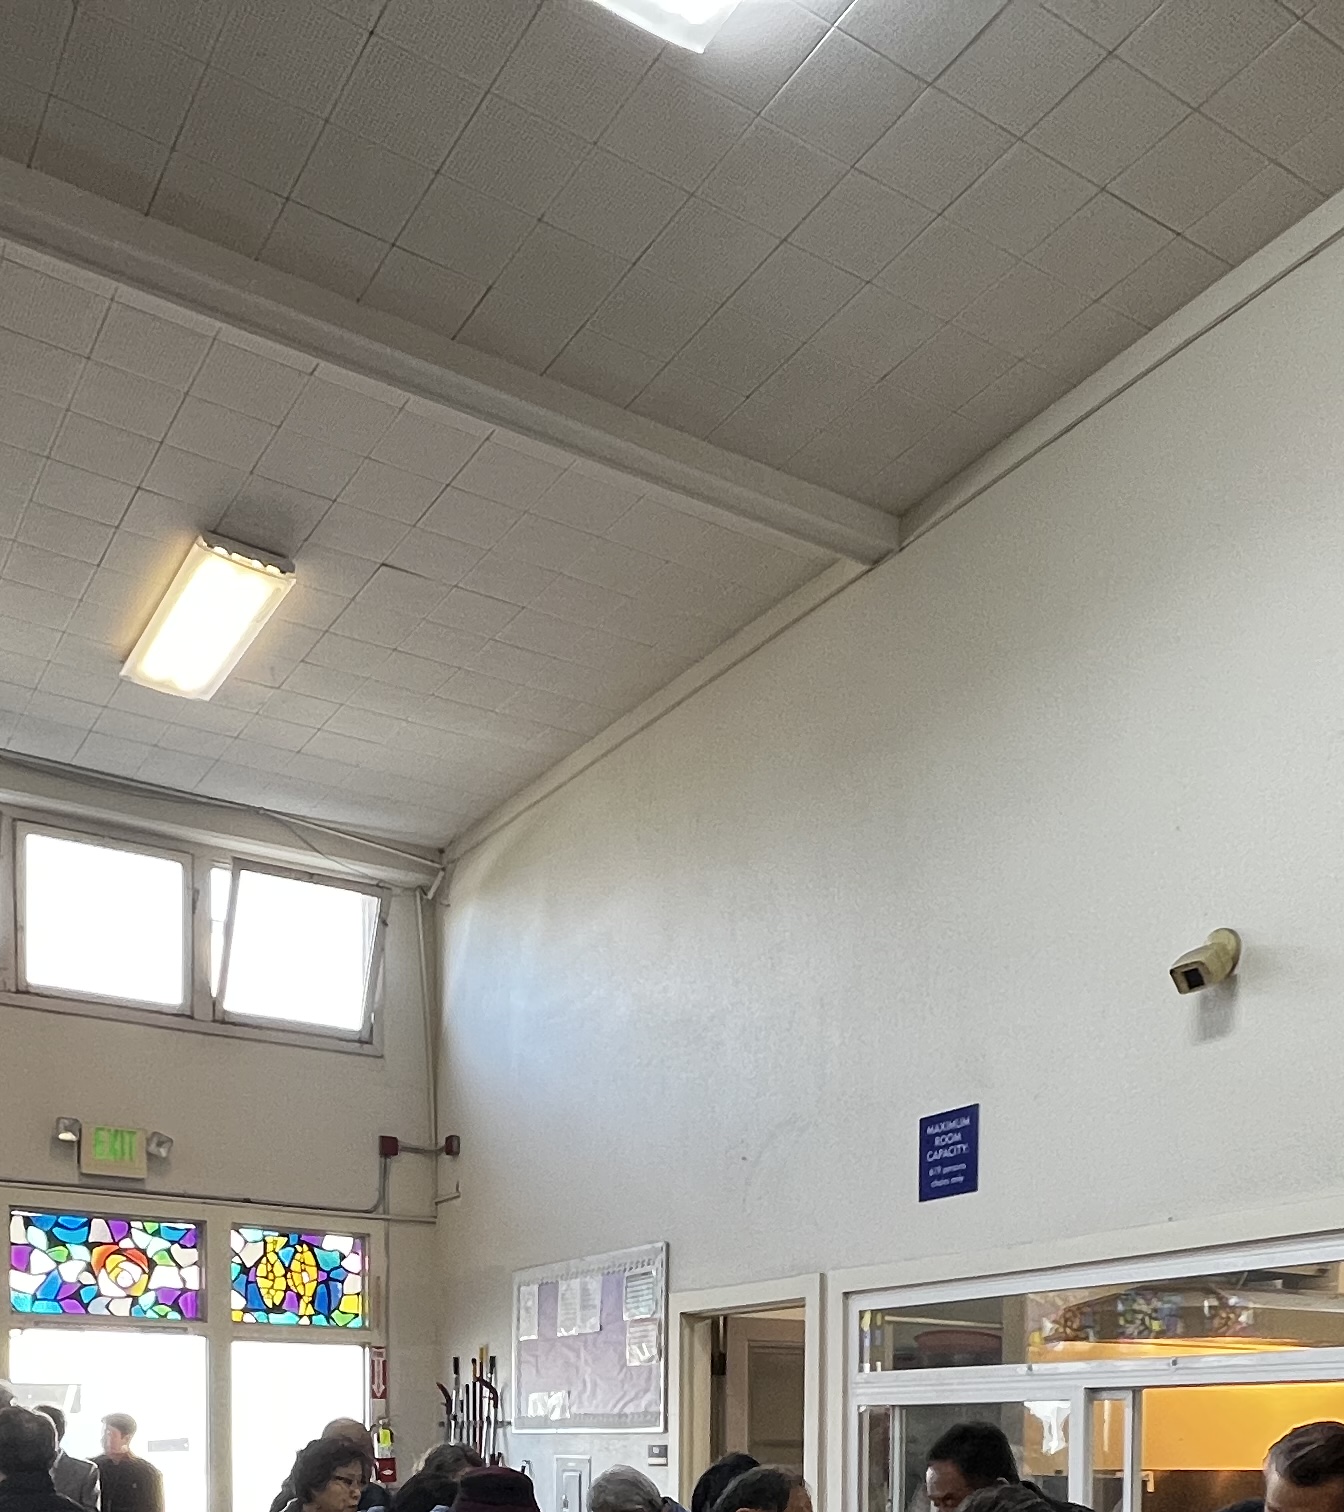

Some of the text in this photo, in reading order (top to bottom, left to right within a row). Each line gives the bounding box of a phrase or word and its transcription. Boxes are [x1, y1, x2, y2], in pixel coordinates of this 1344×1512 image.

[926, 1116, 970, 1135] MAXIMUM
[95, 1127, 137, 1161] EXIT
[934, 1132, 962, 1146] ROOM
